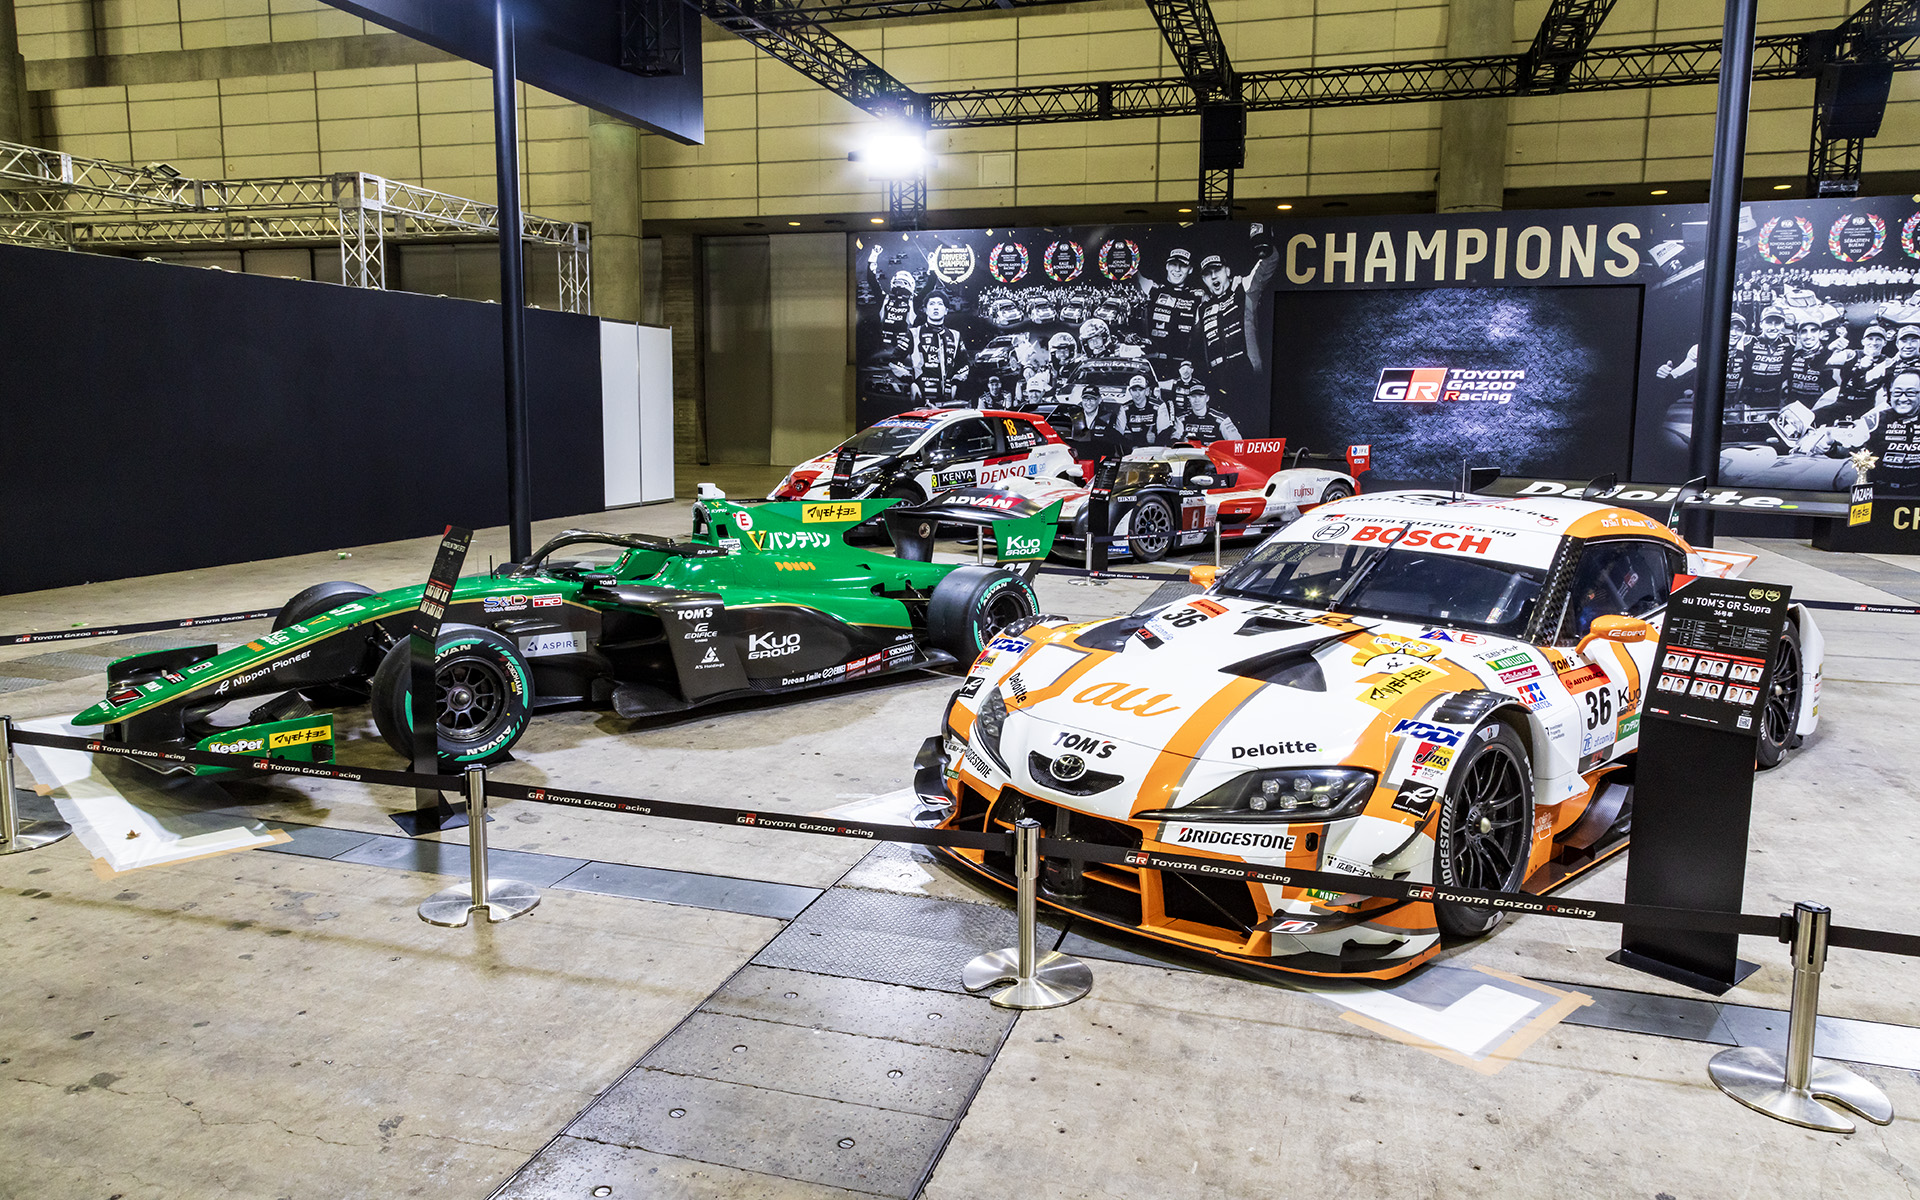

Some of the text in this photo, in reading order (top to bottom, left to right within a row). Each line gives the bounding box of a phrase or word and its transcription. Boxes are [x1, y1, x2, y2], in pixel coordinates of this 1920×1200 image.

[1285, 222, 1641, 285] CHAMPIONS
[939, 260, 969, 268] CHAMPION
[1450, 368, 1525, 380] TOYOTA
[1793, 373, 1818, 382] DENSO
[1377, 381, 1439, 400] GR
[1446, 380, 1516, 391] GAZOO
[1443, 391, 1512, 404] Racing
[1003, 419, 1018, 436] 18
[1235, 443, 1243, 453] HY
[1247, 441, 1281, 453] DENSO
[942, 471, 973, 482] KENYA
[980, 465, 1026, 484] DENSO
[942, 495, 1014, 509] ADVAN
[1517, 480, 1784, 509] Deloite
[740, 513, 749, 526] E
[1191, 509, 1200, 529] 8
[1344, 516, 1397, 525] TOYOTA
[769, 532, 831, 550] バンテリン
[1351, 526, 1492, 554] BOSCH
[1005, 548, 1040, 556] GROUP
[484, 594, 527, 608] S&D
[1682, 597, 1771, 615] au TOM'S GR Supra
[678, 607, 713, 620] TOM'S
[1162, 608, 1208, 628] 36
[684, 631, 718, 639] EDIFICE
[1460, 634, 1478, 644] E
[1621, 629, 1646, 637] EDIFICE
[542, 640, 578, 650] ASPIRE
[748, 645, 801, 660] GROUP
[889, 644, 914, 656] YOKOHAMA
[988, 638, 1029, 653] KDDI
[233, 650, 312, 687] Nippon Pioneer
[1552, 656, 1575, 672] TOM'S
[505, 661, 523, 696] YOKOHAMA
[782, 672, 822, 686] Dream Smile
[1008, 672, 1027, 704] Deloitte
[1072, 682, 1182, 717] au
[1585, 687, 1612, 730] 36
[466, 725, 512, 756] ADVAN
[1392, 719, 1465, 747] KDDI
[87, 743, 186, 762] GR TOYOTA GAZOO Racing
[210, 740, 263, 753] KeePer
[1053, 731, 1117, 759] TOM'S
[1231, 740, 1317, 759] Deloitte
[1415, 745, 1450, 767] jms
[270, 764, 300, 772] TOYOTA
[302, 768, 331, 776] GAZOO
[332, 771, 361, 780] Racing
[528, 790, 651, 814] GR TOYOTA GAZOO Racing
[737, 816, 874, 838] GR TOYOTA GAZOO Racing
[1178, 827, 1297, 850] BRIDGESTONE
[1126, 856, 1291, 884] GR TOYOTA GAZOO Racing
[1408, 888, 1597, 919] GR TOYOTA GAZOO Racing
